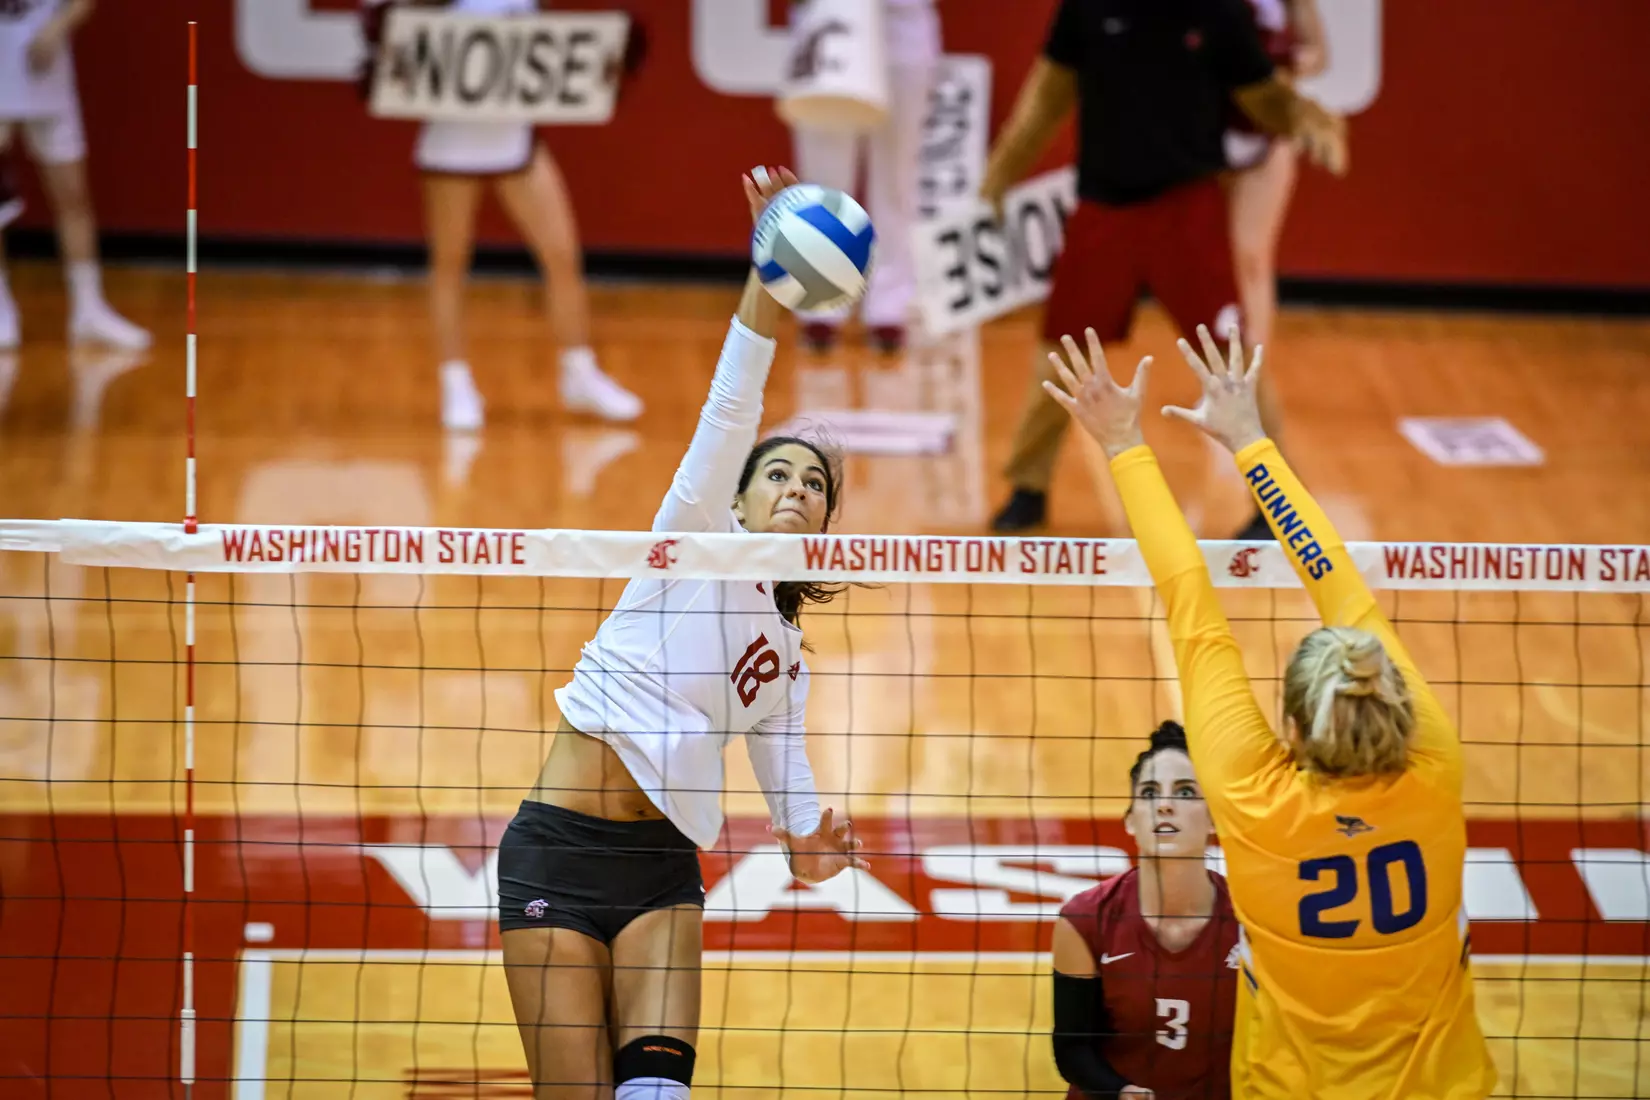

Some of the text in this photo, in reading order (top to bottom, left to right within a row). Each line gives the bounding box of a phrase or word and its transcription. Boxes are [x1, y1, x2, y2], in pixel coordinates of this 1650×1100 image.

[405, 26, 597, 104] NOISE
[221, 529, 526, 565] WASHINGTON STATE
[1245, 463, 1333, 580] RUNNERS
[801, 537, 1108, 575] WASHINGTON STATE
[1383, 545, 1587, 581] WASHINGTON
[730, 632, 780, 708] 18
[1297, 839, 1428, 938] 20
[1155, 997, 1191, 1050] 3
